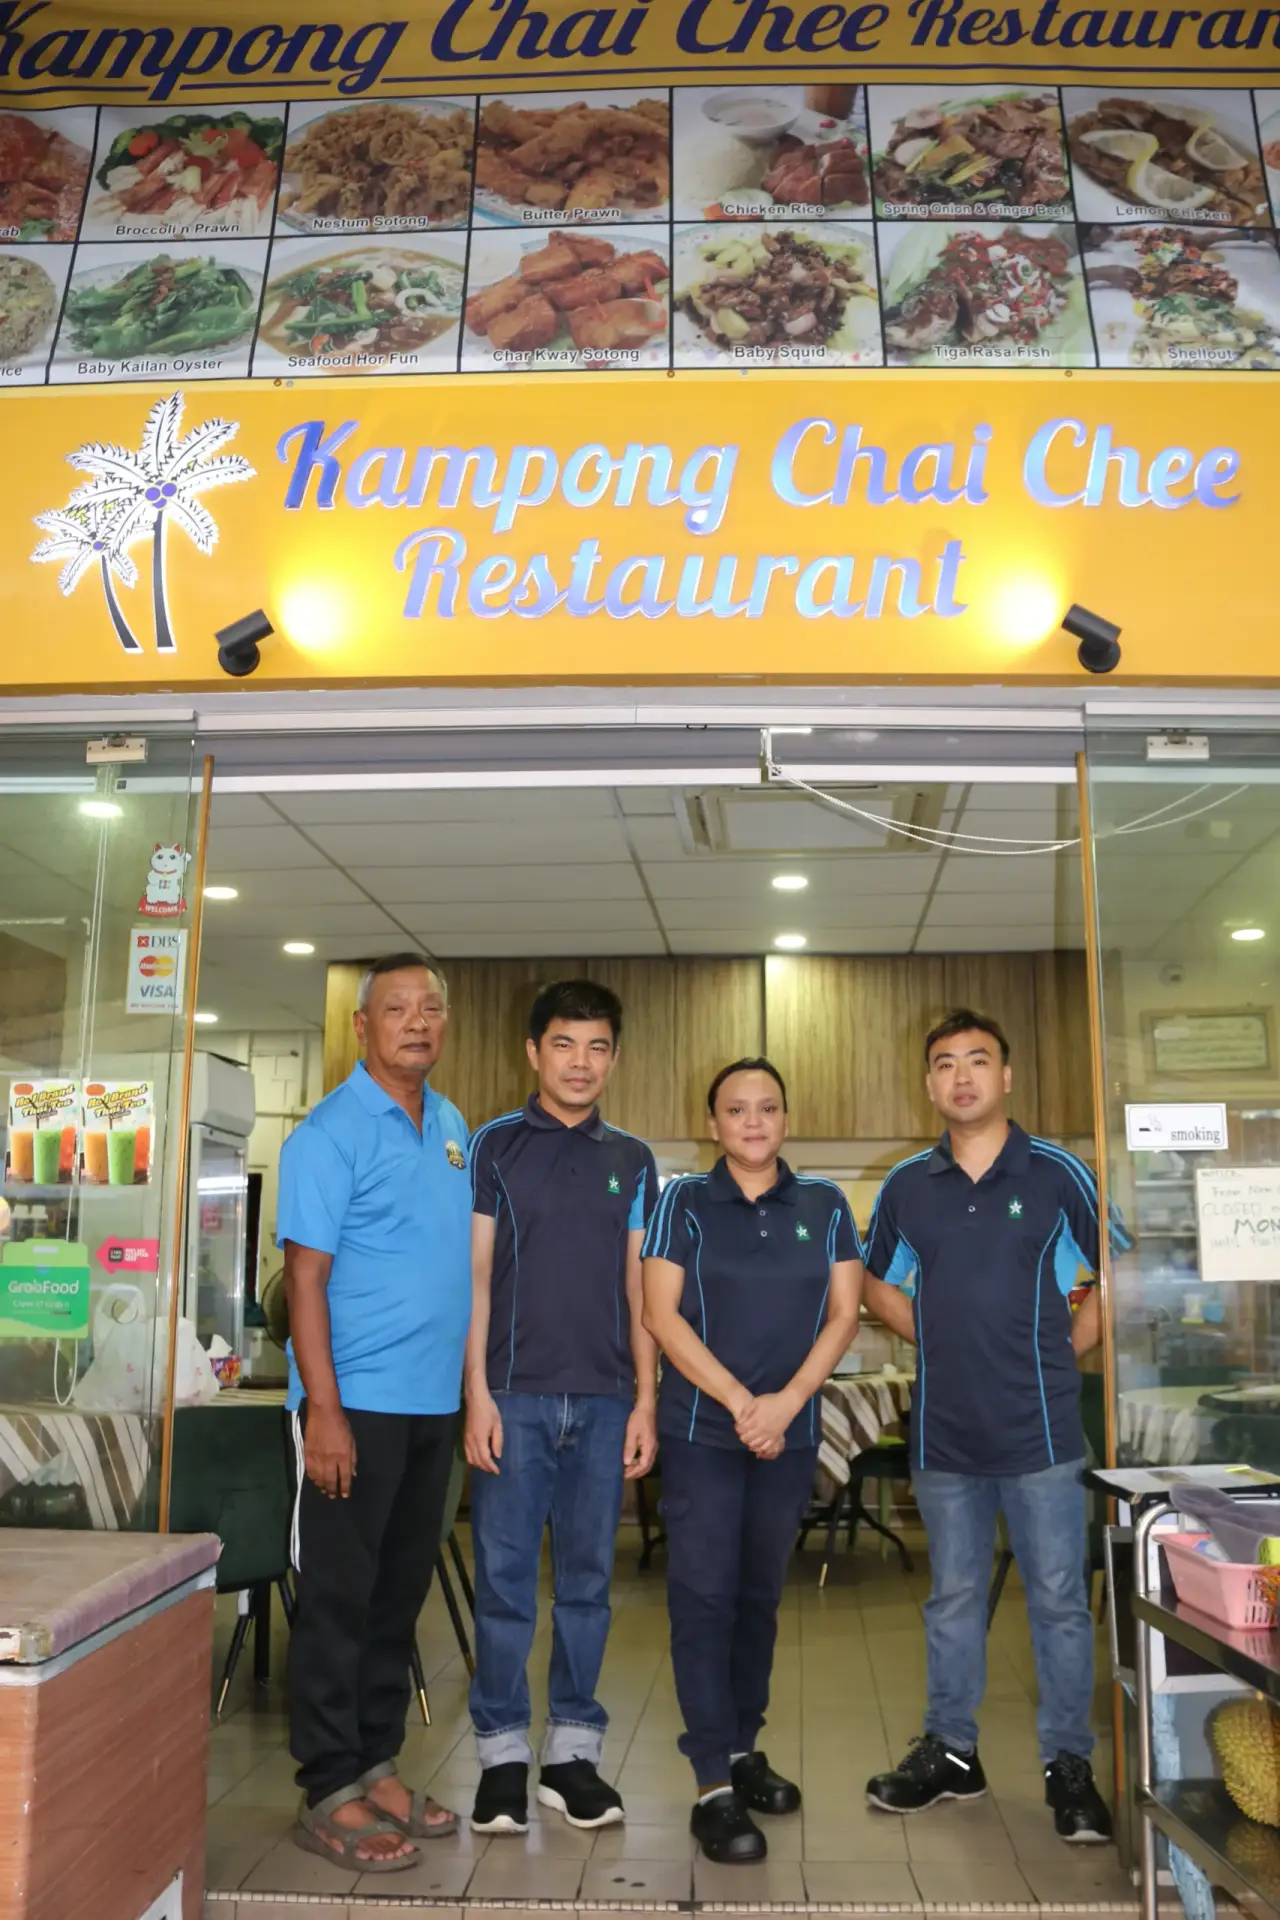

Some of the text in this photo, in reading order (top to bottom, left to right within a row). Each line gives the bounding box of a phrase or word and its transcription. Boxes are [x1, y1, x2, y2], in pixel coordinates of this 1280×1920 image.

[431, 0, 650, 62] Chai
[675, 0, 889, 54] Chee
[523, 207, 620, 222] Butter Prawn
[724, 203, 825, 215] Chicken Rice
[884, 203, 1067, 217] Spring Onion & Ginger Beef
[1116, 206, 1231, 221] Lemon Chicken
[312, 214, 429, 229] Nestum Sotong
[0, 227, 19, 238] ab
[115, 223, 240, 236] Broccoli n Prawn
[287, 352, 419, 368] Seafood Hor Fun
[492, 348, 640, 363] Char Kway Sotong
[734, 346, 825, 360] Baby Squid
[934, 346, 1050, 360] Tiga Rasa Fish
[1168, 348, 1233, 360] Shellout
[0, 366, 22, 377] ice
[77, 359, 223, 376] Baby Kailan Oyster
[276, 417, 1242, 534] Kampong Chai Chee
[394, 527, 969, 619] Restaurant
[140, 984, 174, 998] VISA
[1171, 1126, 1221, 1144] smoking
[8, 1279, 79, 1295] GrabFood
